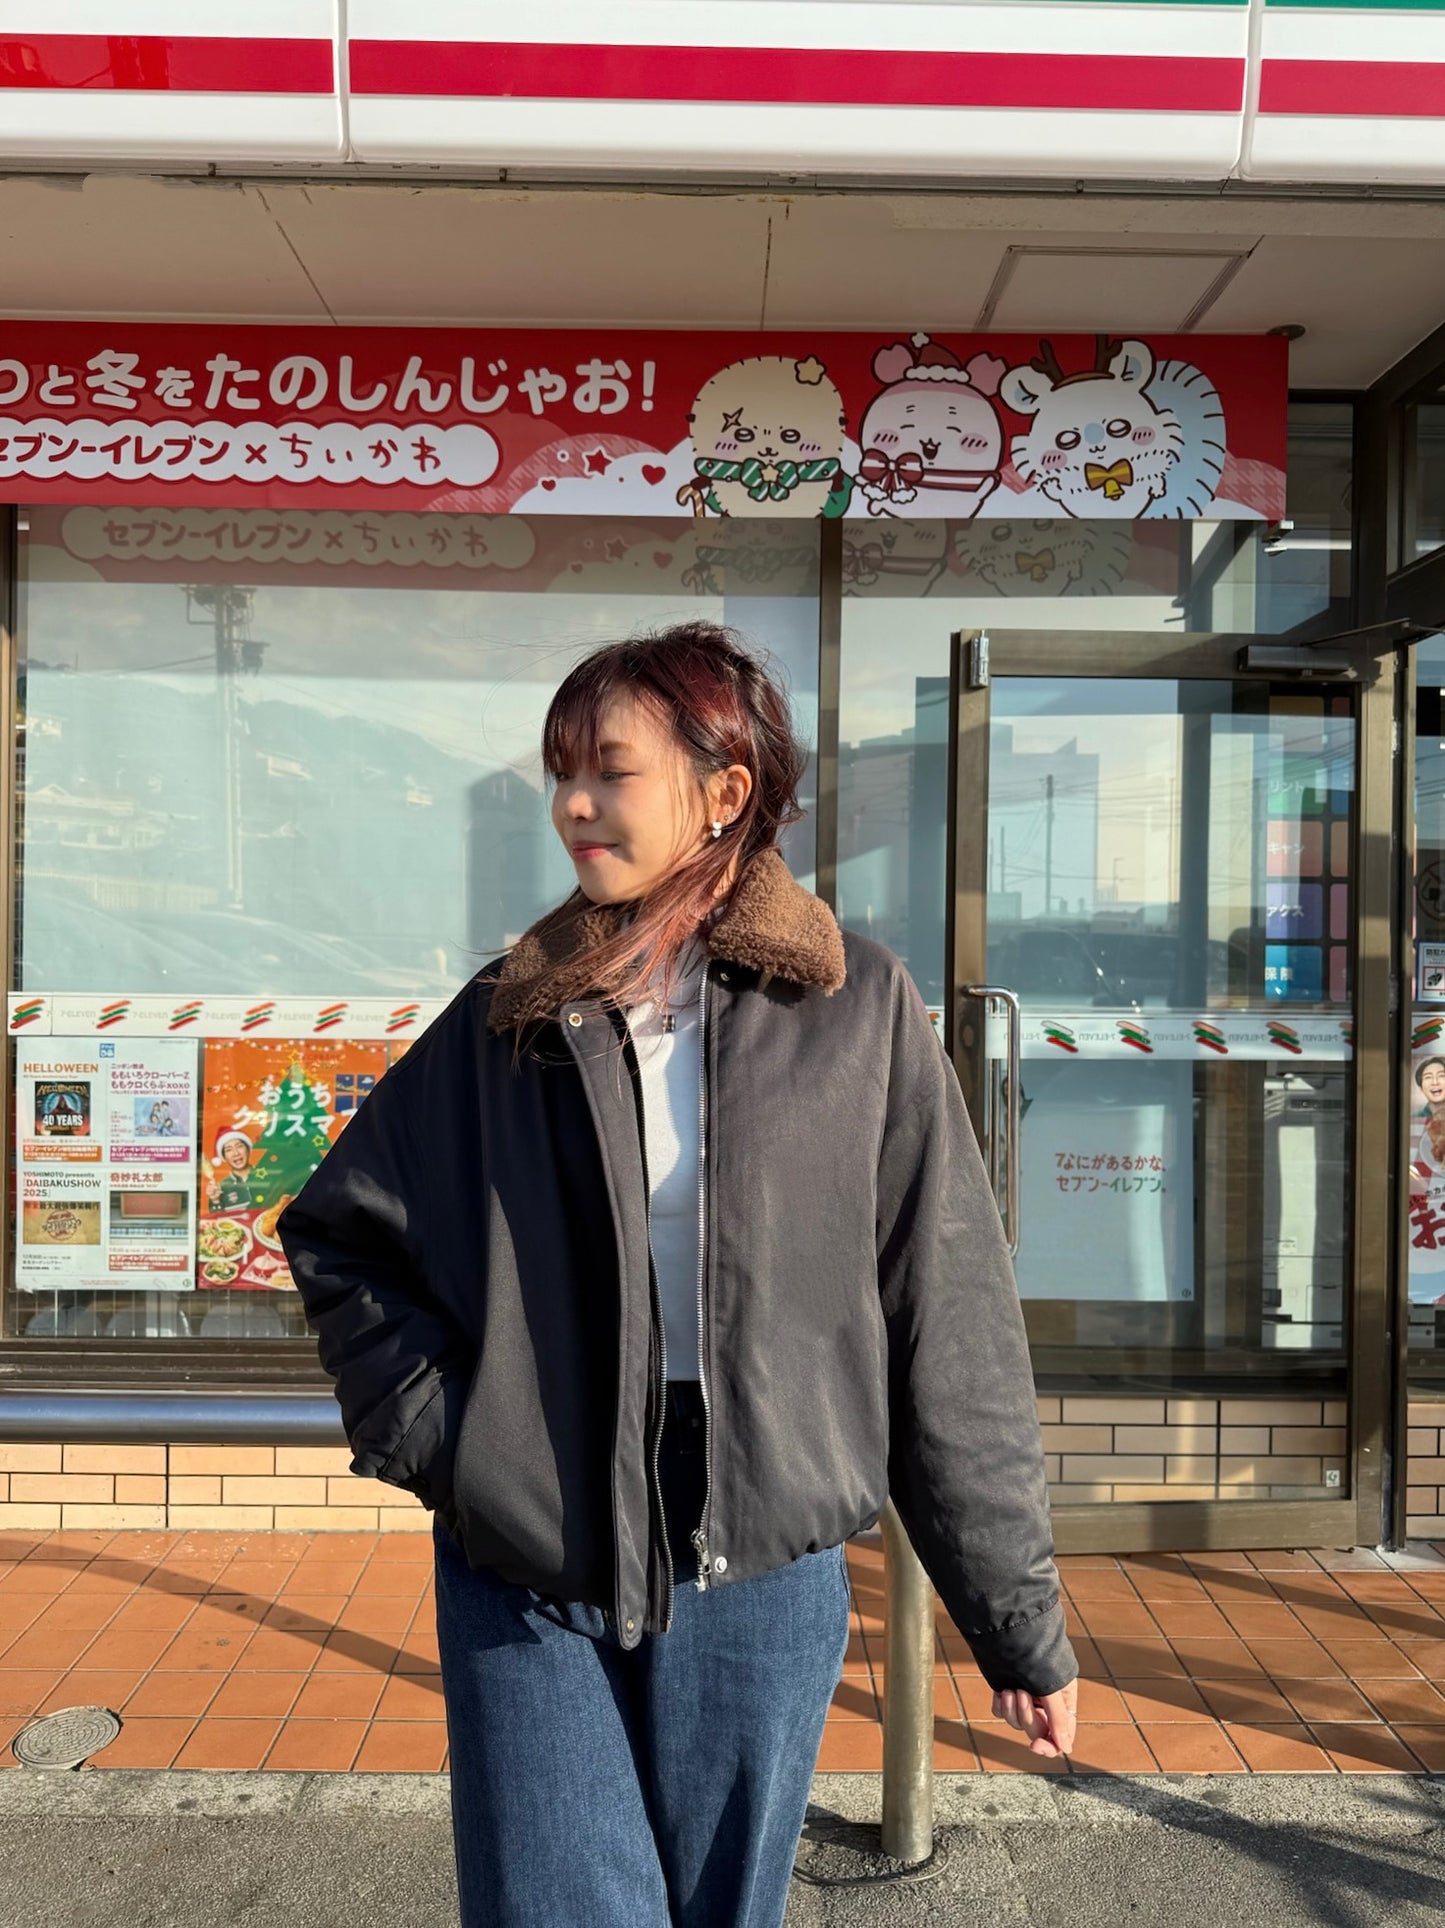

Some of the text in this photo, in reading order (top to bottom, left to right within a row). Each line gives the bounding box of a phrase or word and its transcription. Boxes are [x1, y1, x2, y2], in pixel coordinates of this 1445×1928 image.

[23, 1063, 99, 1073] HELLOWEEN
[42, 1114, 83, 1126] 40 YEARS
